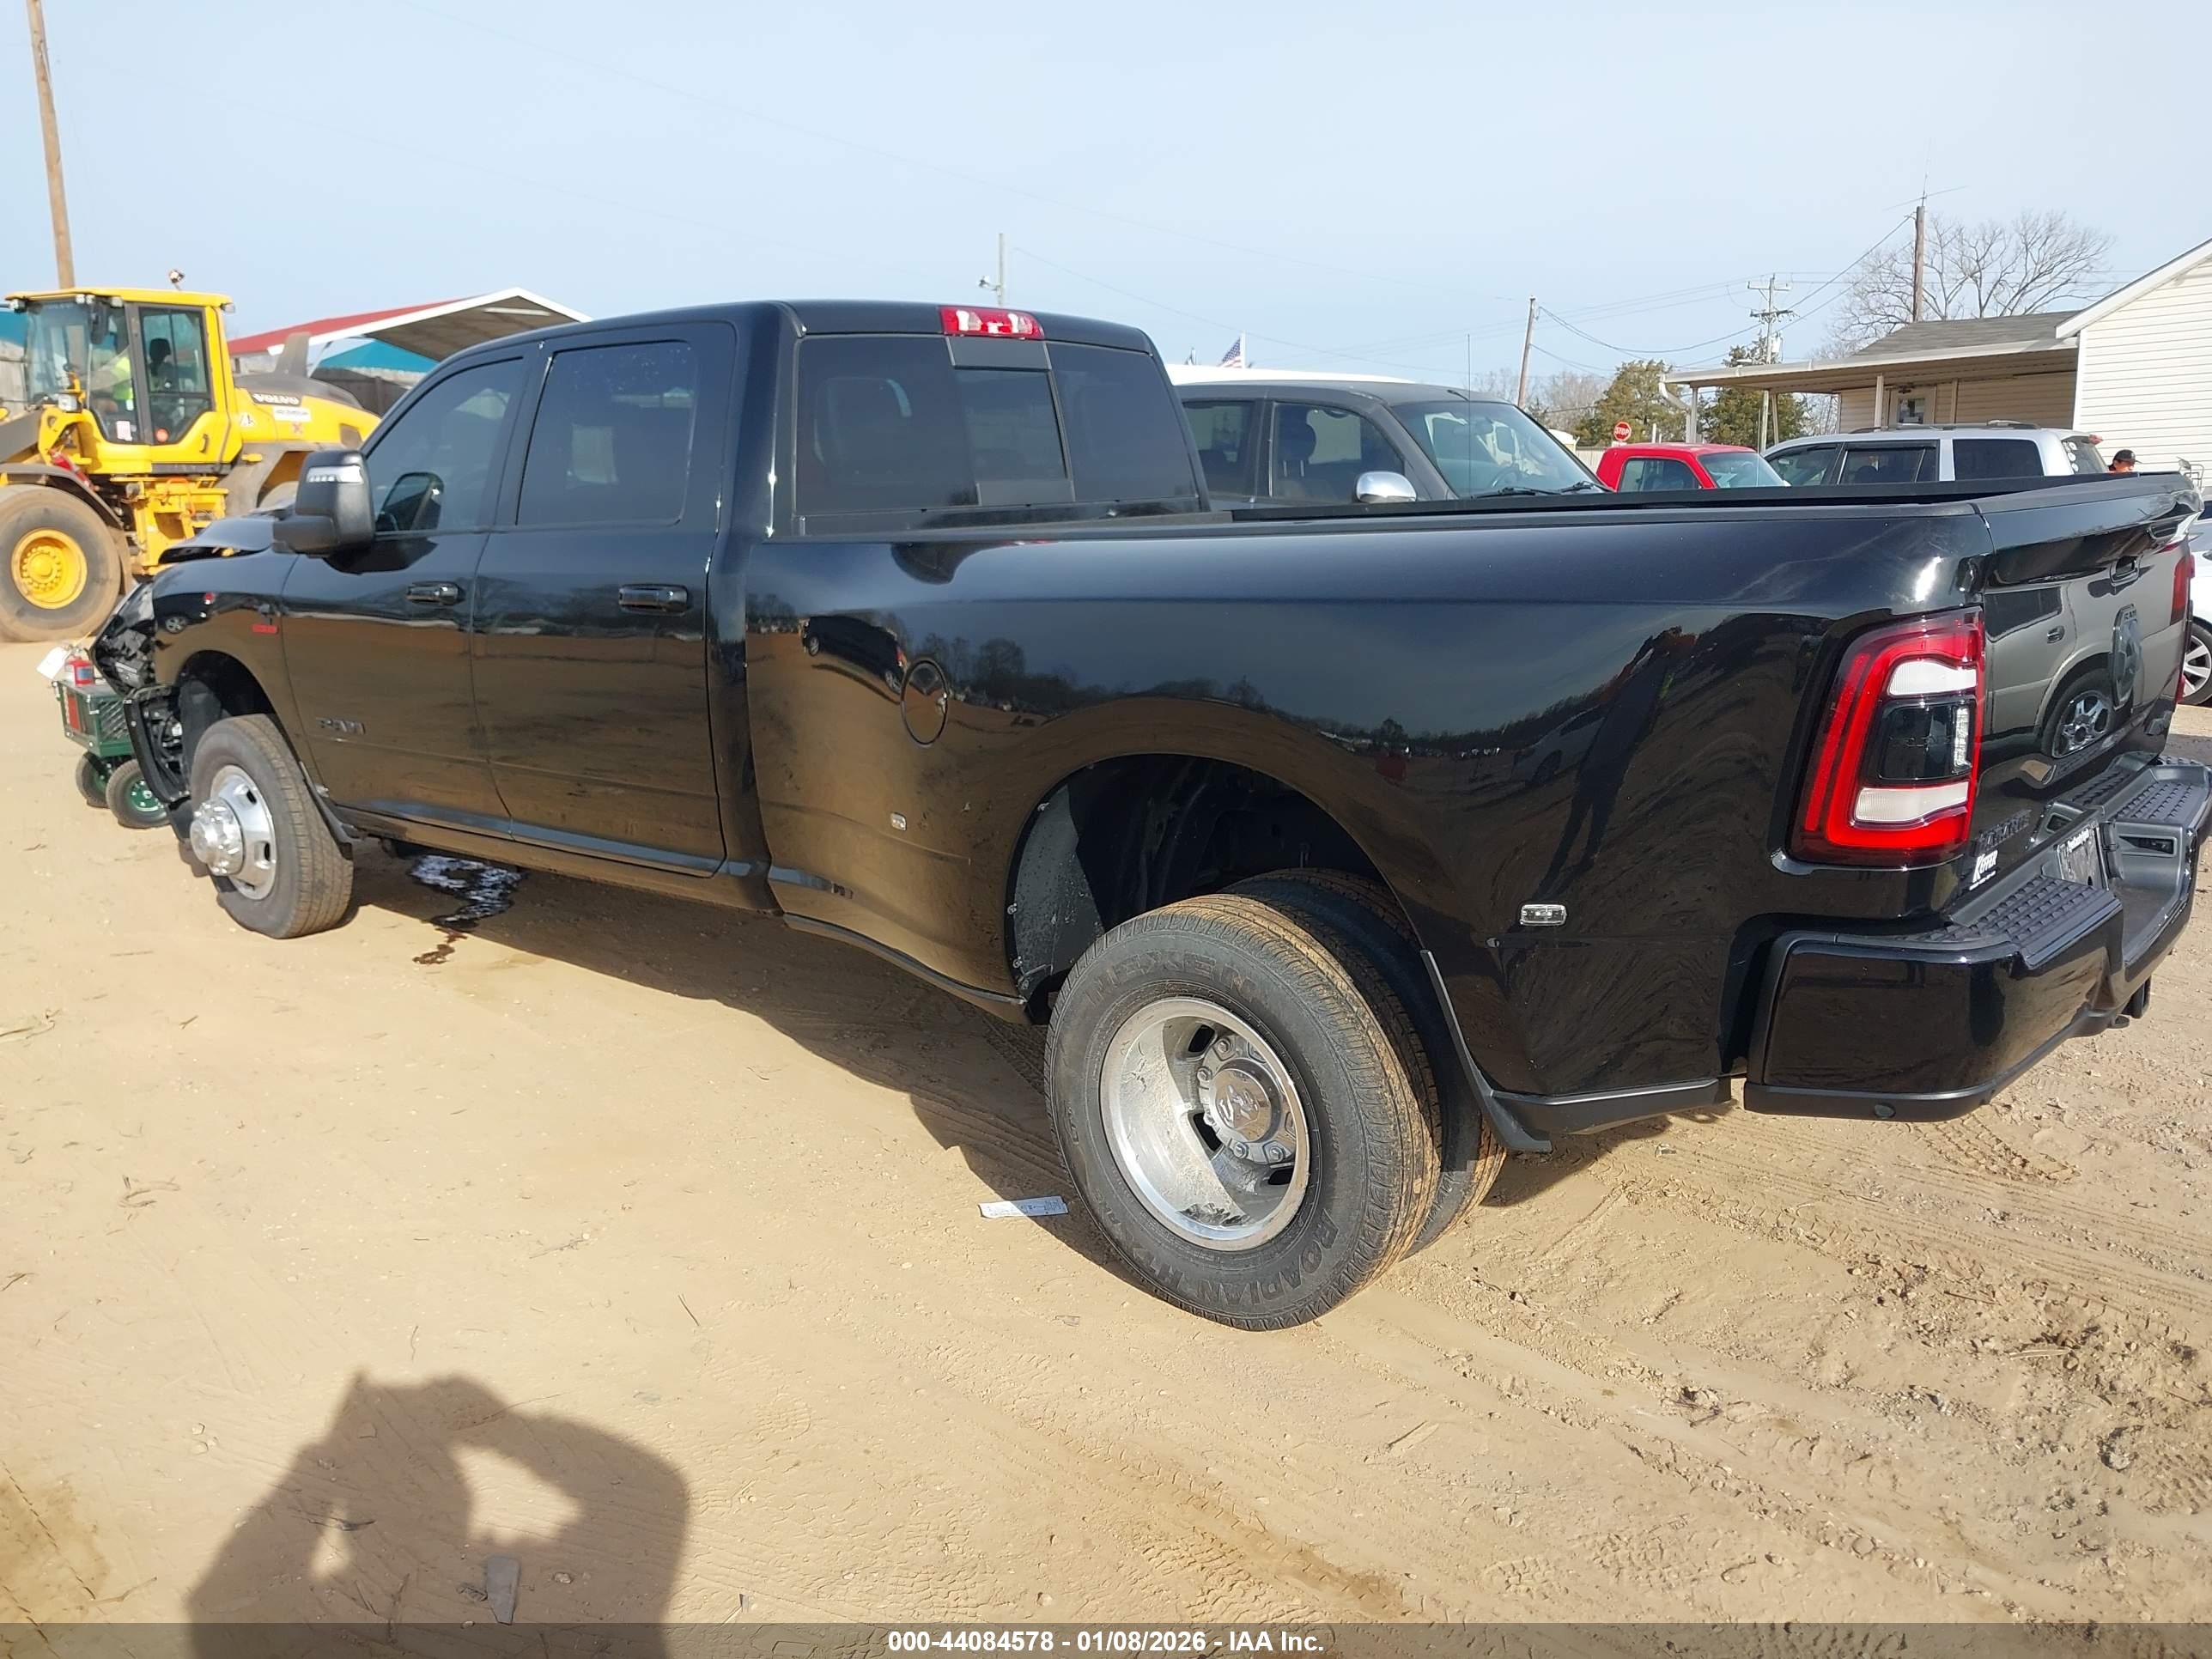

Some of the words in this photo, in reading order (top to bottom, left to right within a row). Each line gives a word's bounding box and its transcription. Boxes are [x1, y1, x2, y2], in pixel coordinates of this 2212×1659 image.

[252, 393, 300, 405] VOLVO
[1614, 426, 1630, 435] STOP
[1196, 1207, 1340, 1306] ROADIAN
